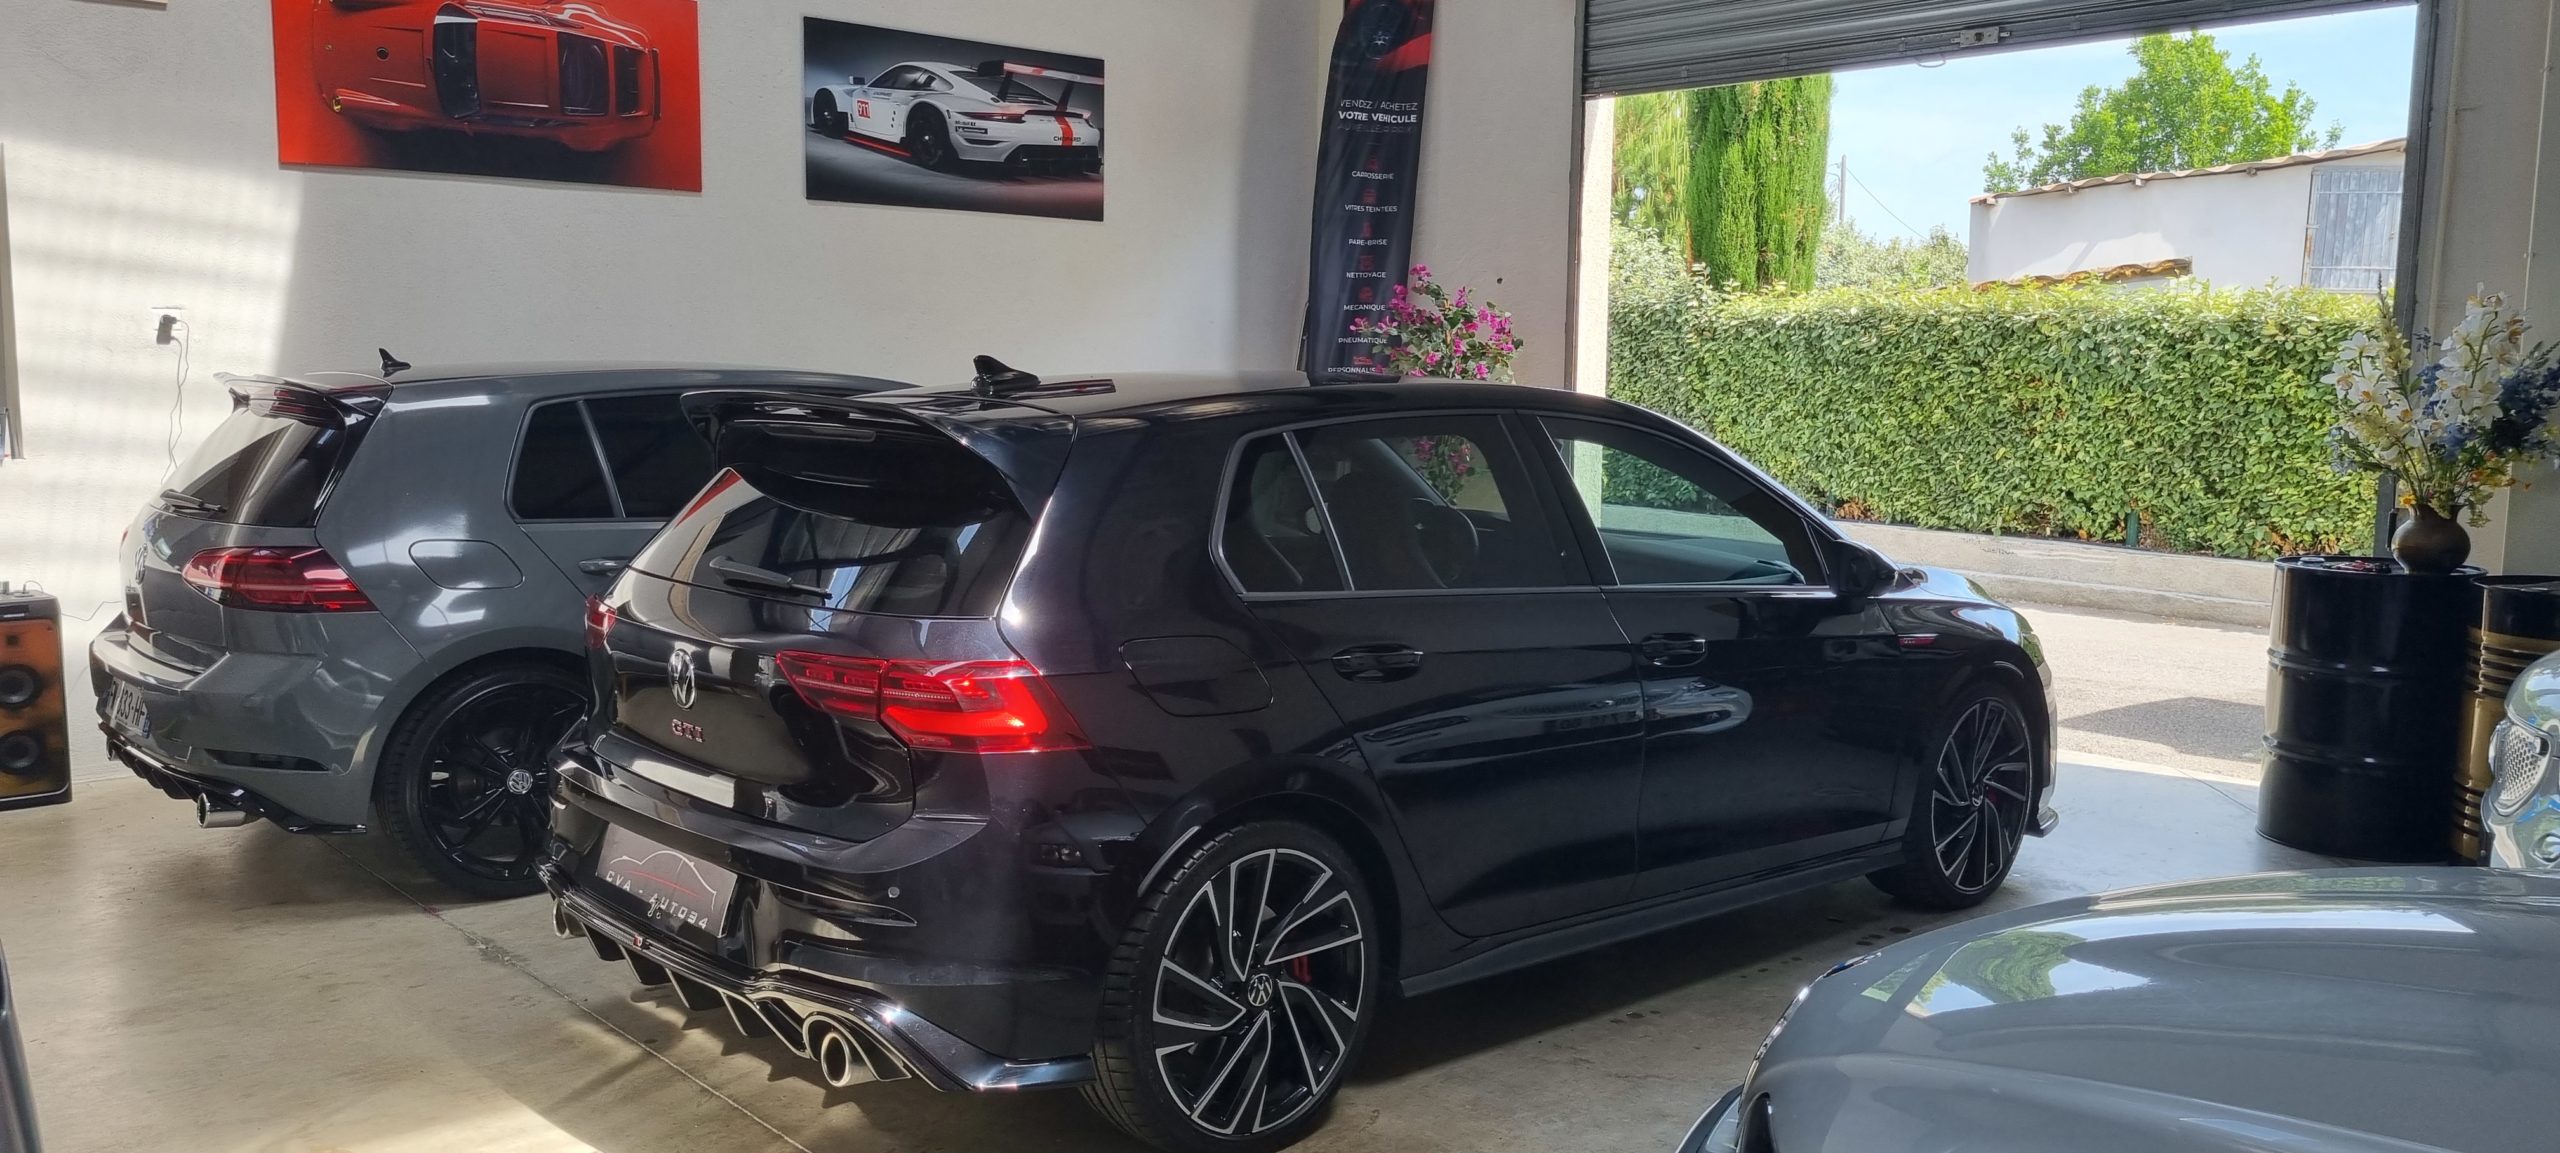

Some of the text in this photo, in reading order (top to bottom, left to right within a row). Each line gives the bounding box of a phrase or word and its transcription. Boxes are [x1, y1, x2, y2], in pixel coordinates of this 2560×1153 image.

[1340, 99, 1373, 109] VENDEZ
[1380, 101, 1418, 111] ACHETEZ
[1338, 110, 1417, 123] VOTRE VEHICULE
[1348, 238, 1388, 246] PARE-BRISE
[1346, 271, 1387, 279] NETTOYAGE
[1343, 303, 1386, 312] MECANIQUE
[1338, 336, 1388, 345] PNEUMATIQUE
[672, 719, 704, 743] GTI
[606, 870, 632, 892] CVA
